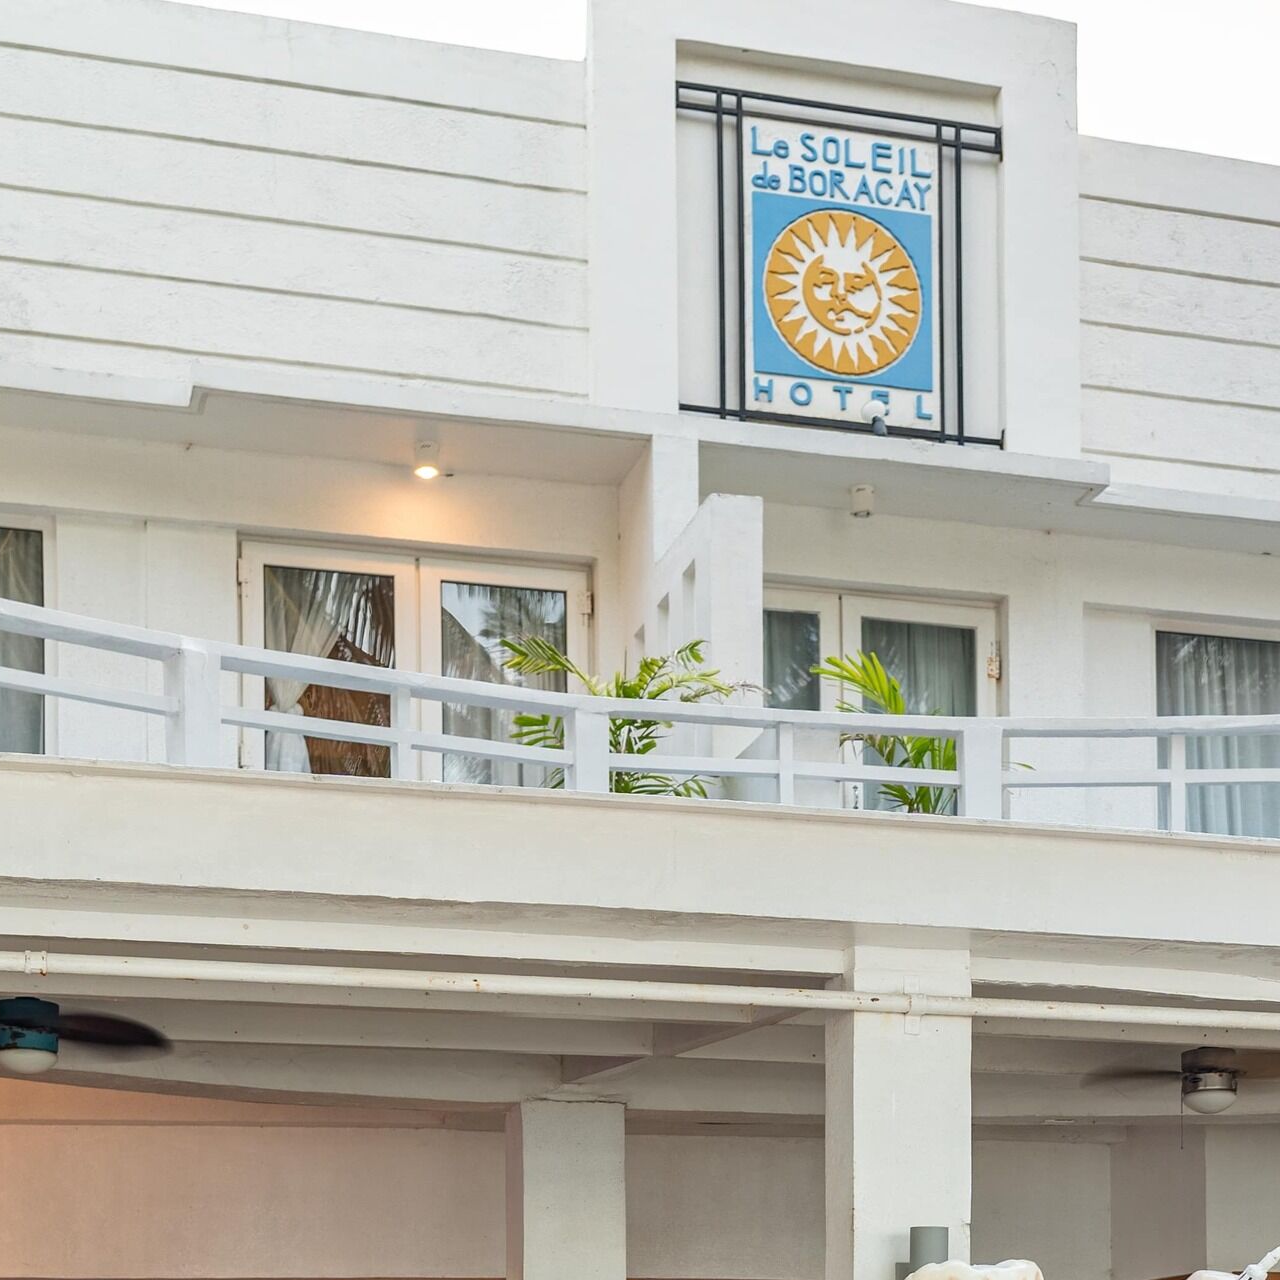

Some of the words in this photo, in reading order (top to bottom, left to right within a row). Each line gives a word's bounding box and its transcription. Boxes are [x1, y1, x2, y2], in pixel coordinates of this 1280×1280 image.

[751, 126, 789, 159] Le
[800, 132, 932, 179] SOLEIL
[751, 161, 781, 190] de
[788, 164, 932, 211] BORACAY
